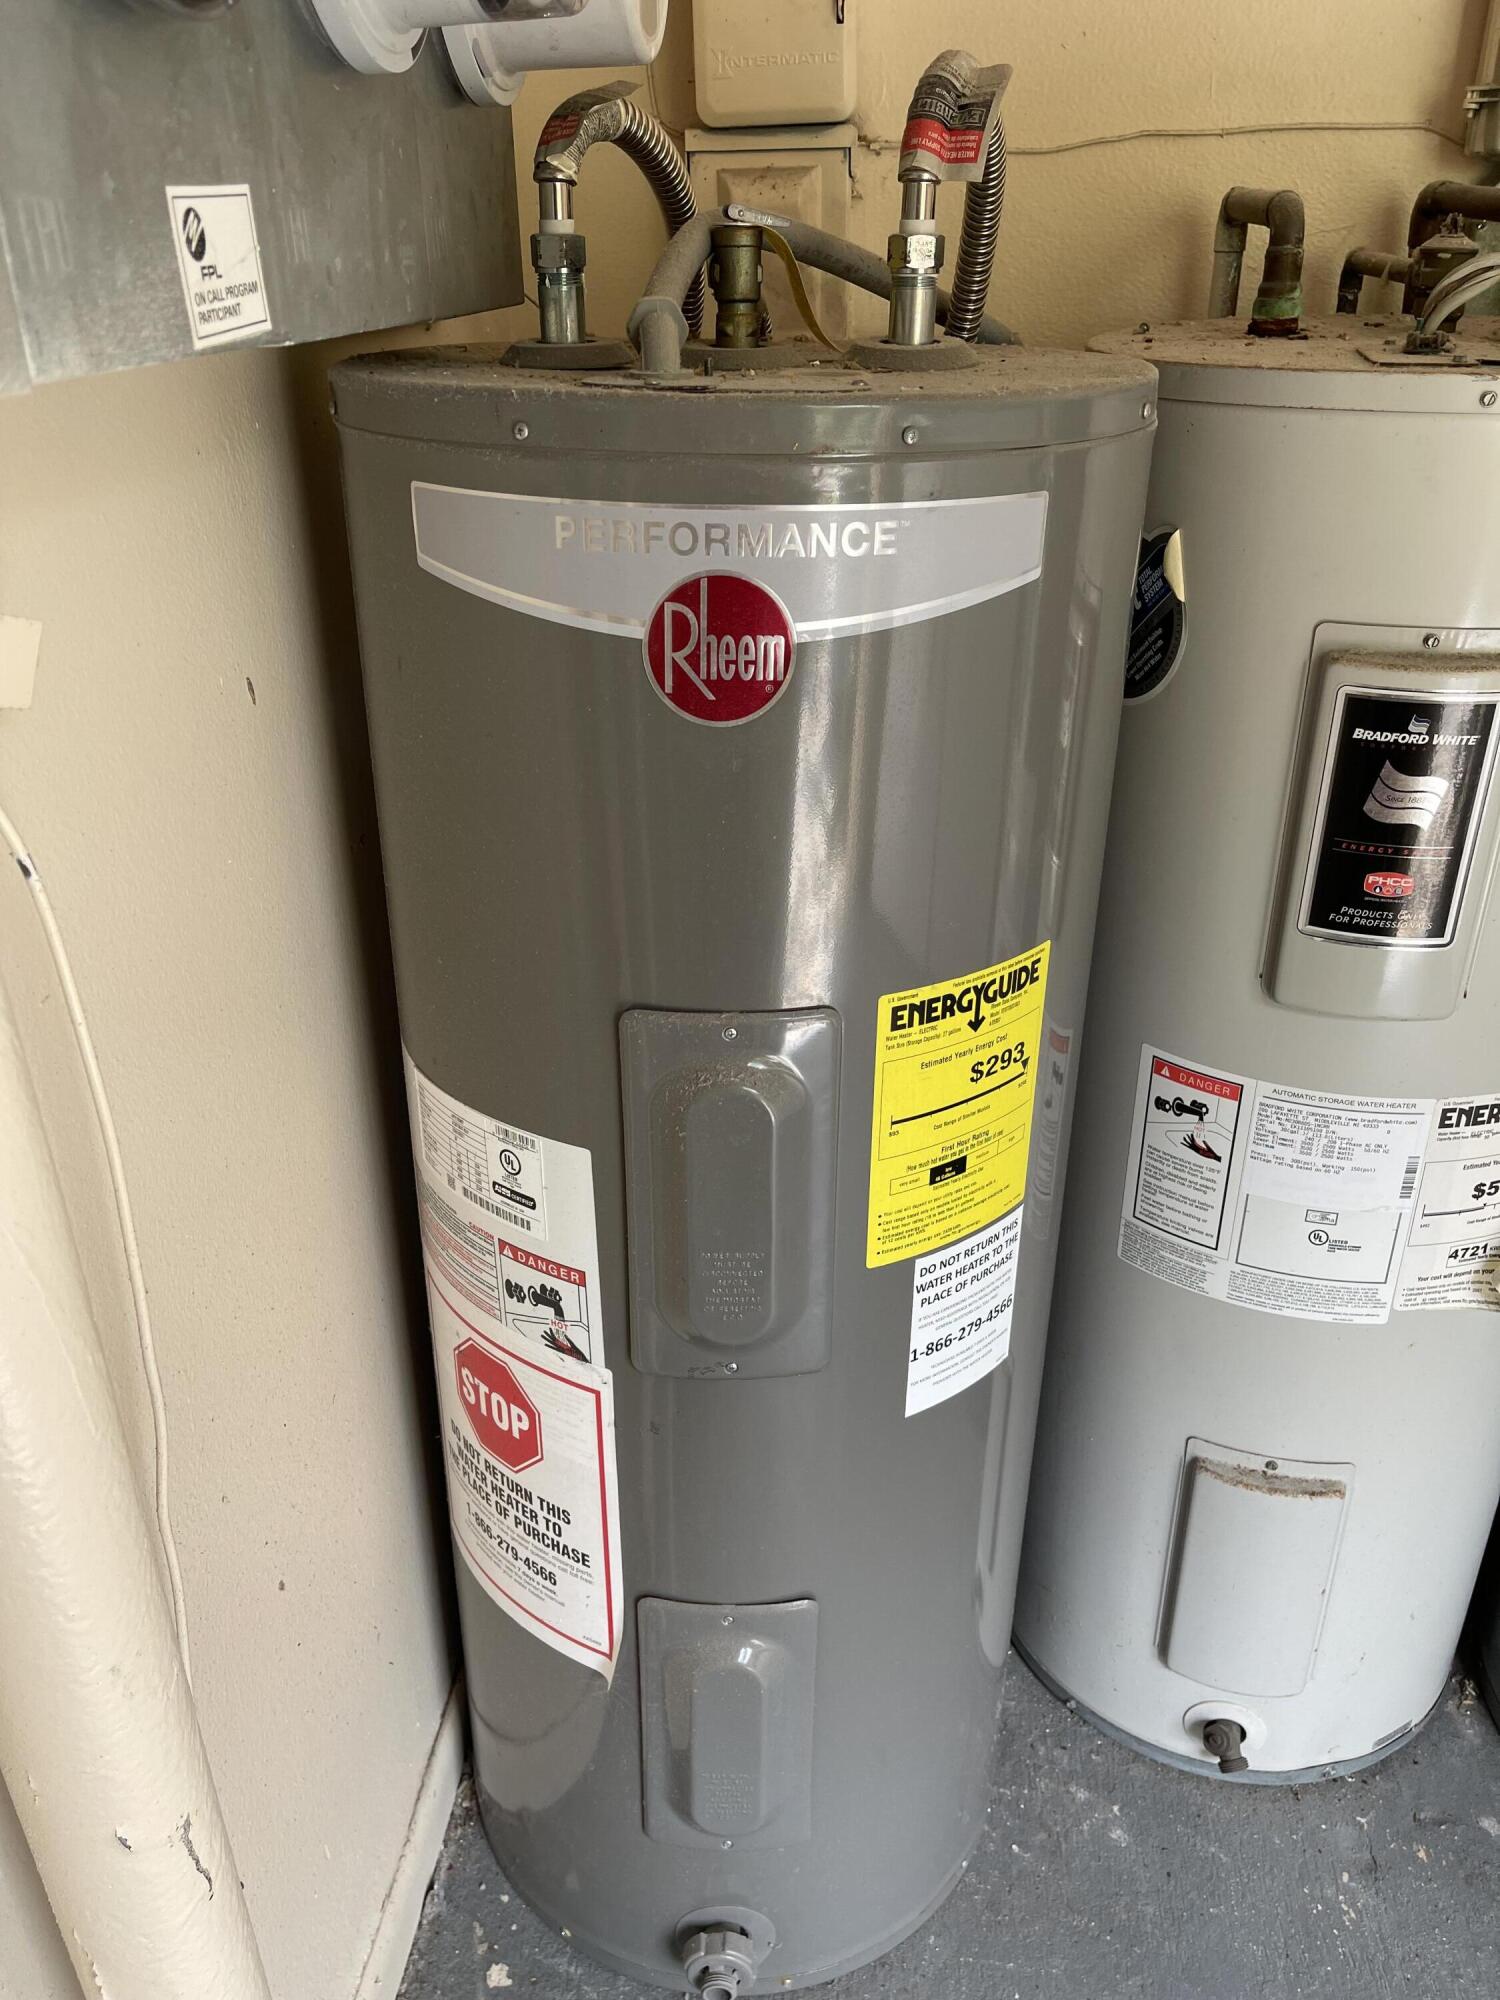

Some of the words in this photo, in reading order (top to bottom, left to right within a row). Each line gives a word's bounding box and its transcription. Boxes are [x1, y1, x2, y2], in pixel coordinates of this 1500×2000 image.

[710, 47, 839, 80] INTERMATIC
[200, 265, 223, 280] FPL
[195, 292, 206, 306] ON
[207, 288, 224, 303] CALL
[225, 280, 258, 299] PROGRAM
[198, 303, 240, 325] PARTICIPANT
[553, 516, 899, 558] PERFORMANCE
[664, 578, 785, 700] Rheem
[1352, 728, 1429, 745] BRADFORD
[1432, 734, 1479, 745] WHITE
[1342, 843, 1394, 854] ENERGY
[1368, 876, 1413, 886] PHCC
[1329, 913, 1349, 924] FOR
[1352, 918, 1432, 929] PROFESSIONALS
[1340, 906, 1394, 919] PRODUCTS
[890, 957, 1041, 1032] ENERGYGUIDE
[919, 1025, 938, 1034] ELECTRIC
[921, 1055, 952, 1069] Estimated
[955, 1048, 973, 1059] Yearly
[976, 1039, 995, 1052] Energy
[996, 1034, 1008, 1043] Cost
[970, 1041, 1025, 1084] $293
[1180, 1073, 1230, 1096] DANGER
[1272, 1089, 1316, 1101] AUTOMATIC
[1318, 1096, 1356, 1106] STORAGE
[1259, 1102, 1284, 1111] BRADFORD
[1306, 1111, 1342, 1120] CORPORATION
[942, 1143, 954, 1153] First
[957, 1138, 970, 1147] Hour
[972, 1130, 990, 1140] Rating
[504, 1153, 516, 1171] UL
[1463, 1161, 1491, 1170] Estimated
[469, 1222, 494, 1240] CAUTION
[1313, 1233, 1323, 1242] UL
[920, 1264, 936, 1278] DO
[940, 1253, 962, 1270] NOT
[964, 1234, 1000, 1259] RETURN
[1002, 1218, 1018, 1236] THIS
[1448, 1243, 1488, 1259] 4721
[518, 1251, 579, 1283] DANGER
[916, 1272, 952, 1294] WATER
[955, 1253, 990, 1278] HEATER
[992, 1245, 1003, 1258] TO
[1005, 1232, 1019, 1249] THE
[921, 1287, 953, 1308] PLACE
[955, 1280, 968, 1293] OF
[970, 1250, 1013, 1285] PURCHASE
[551, 1320, 568, 1331] HOT
[910, 1293, 1013, 1363] 1-866-279-4566
[461, 1366, 529, 1440] STOP
[451, 1417, 461, 1441] DO
[463, 1436, 480, 1464] NOT
[484, 1458, 532, 1505] RETURN
[537, 1496, 571, 1525] THIS
[456, 1442, 487, 1487] WATER
[491, 1479, 538, 1524] HEATER
[543, 1516, 562, 1537] TO
[449, 1440, 460, 1471] THE
[462, 1466, 492, 1507] PLACE
[495, 1500, 509, 1520] OF
[514, 1516, 591, 1569] PURCHASE
[467, 1503, 557, 1586] 1-866-279-4566
